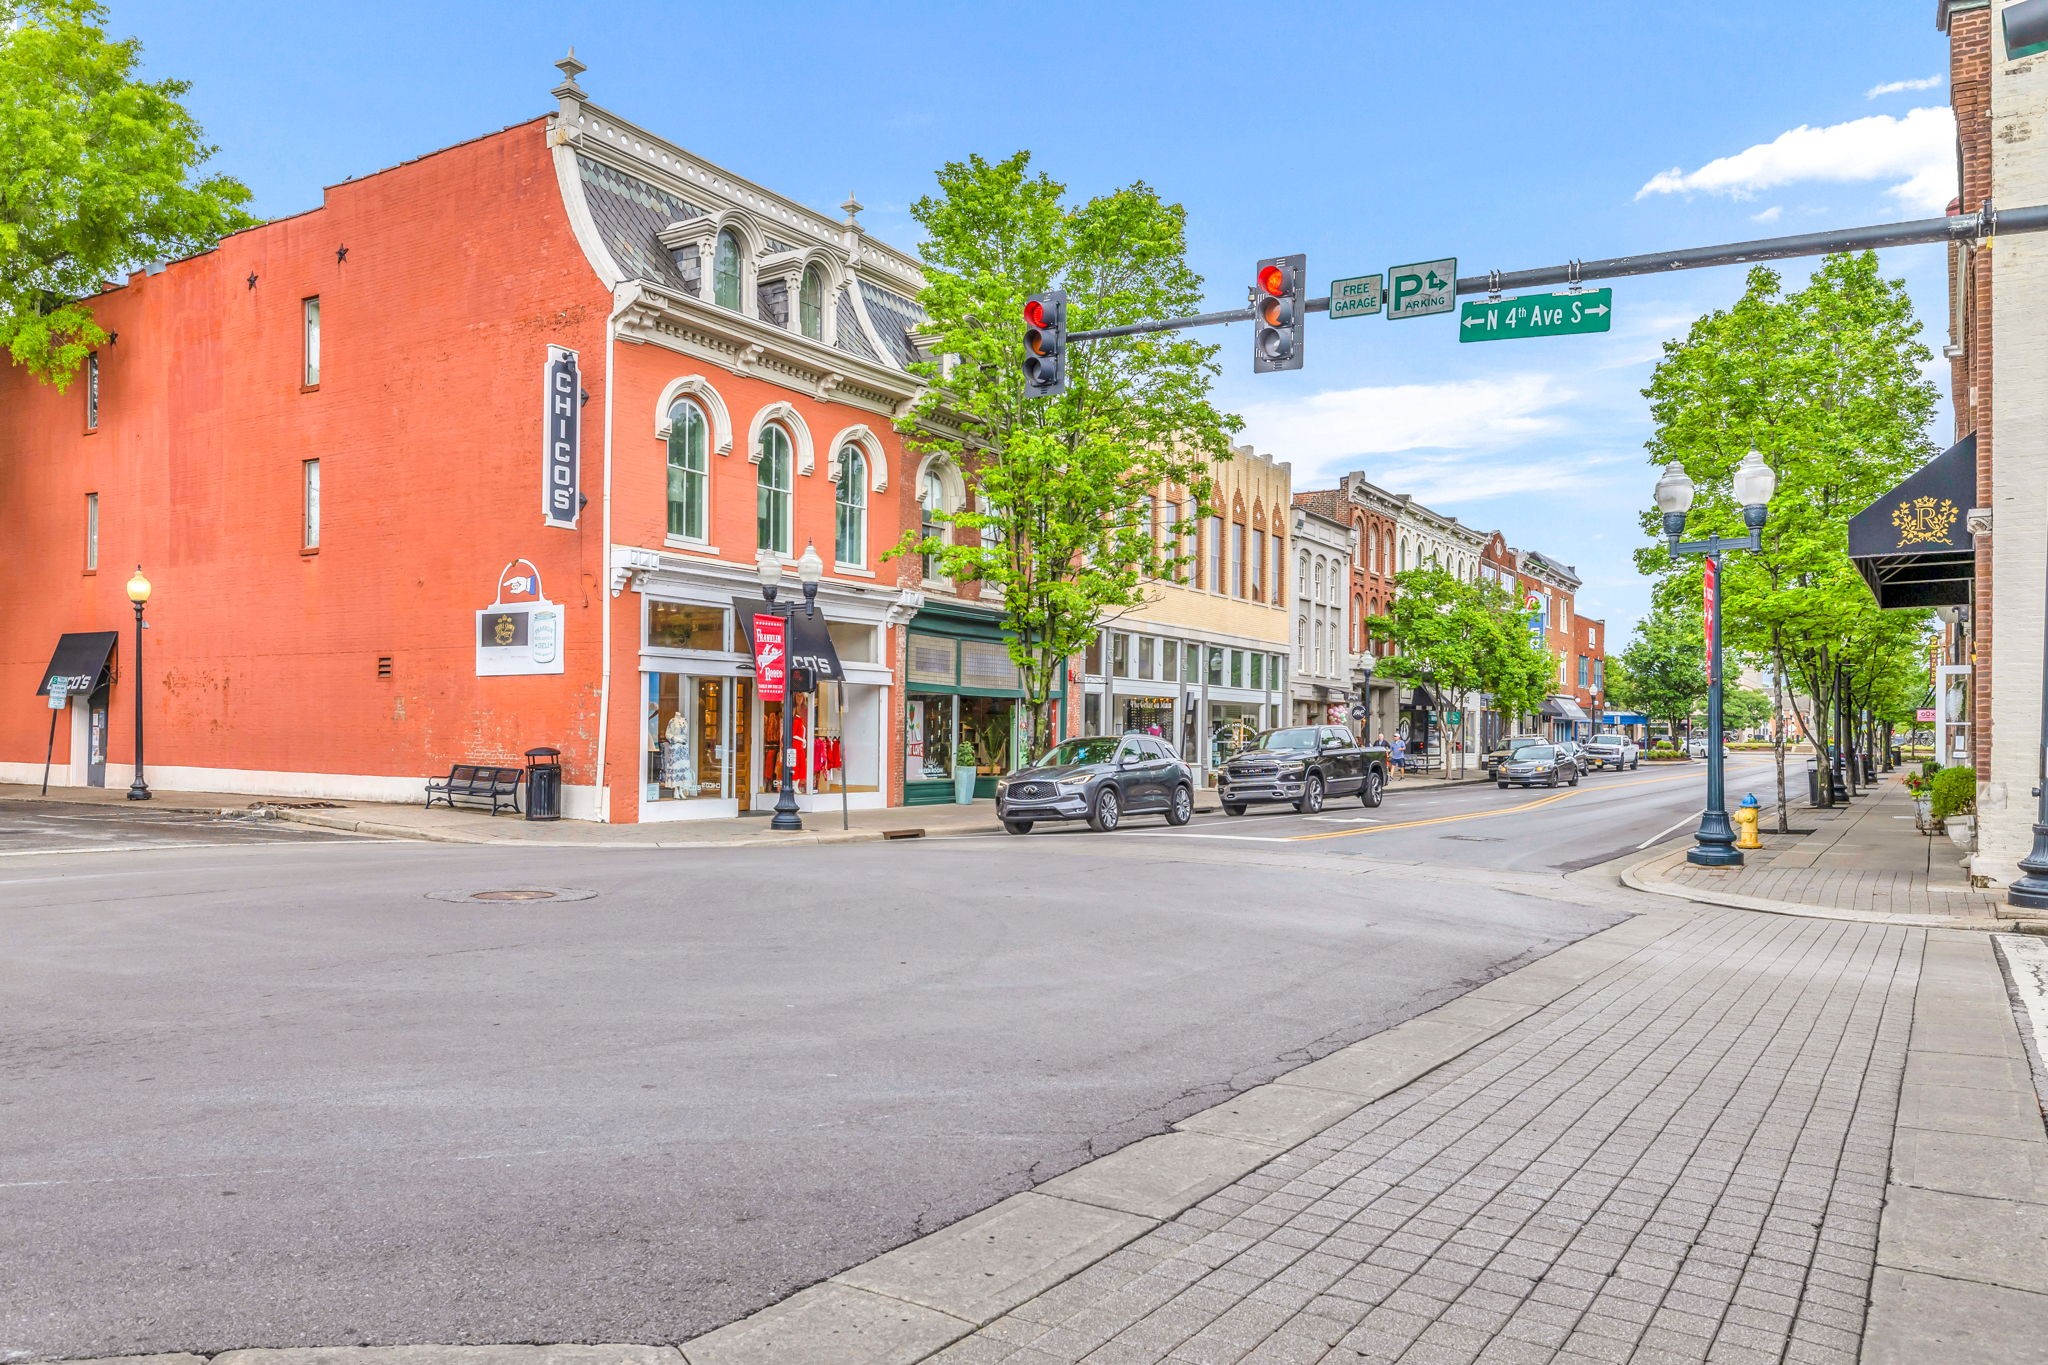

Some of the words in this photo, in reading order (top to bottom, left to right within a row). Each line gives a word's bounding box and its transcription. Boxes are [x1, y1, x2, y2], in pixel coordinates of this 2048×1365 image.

[1343, 283, 1370, 296] FREE
[1335, 296, 1377, 311] GARAGE
[1487, 309, 1498, 331] N
[1505, 307, 1527, 329] 4th
[1530, 305, 1563, 327] Ave
[1570, 301, 1582, 324] S
[554, 371, 574, 510] CHICO'S
[1914, 507, 1938, 531] R
[756, 629, 782, 643] FRANKLIN
[765, 667, 784, 681] RODEO
